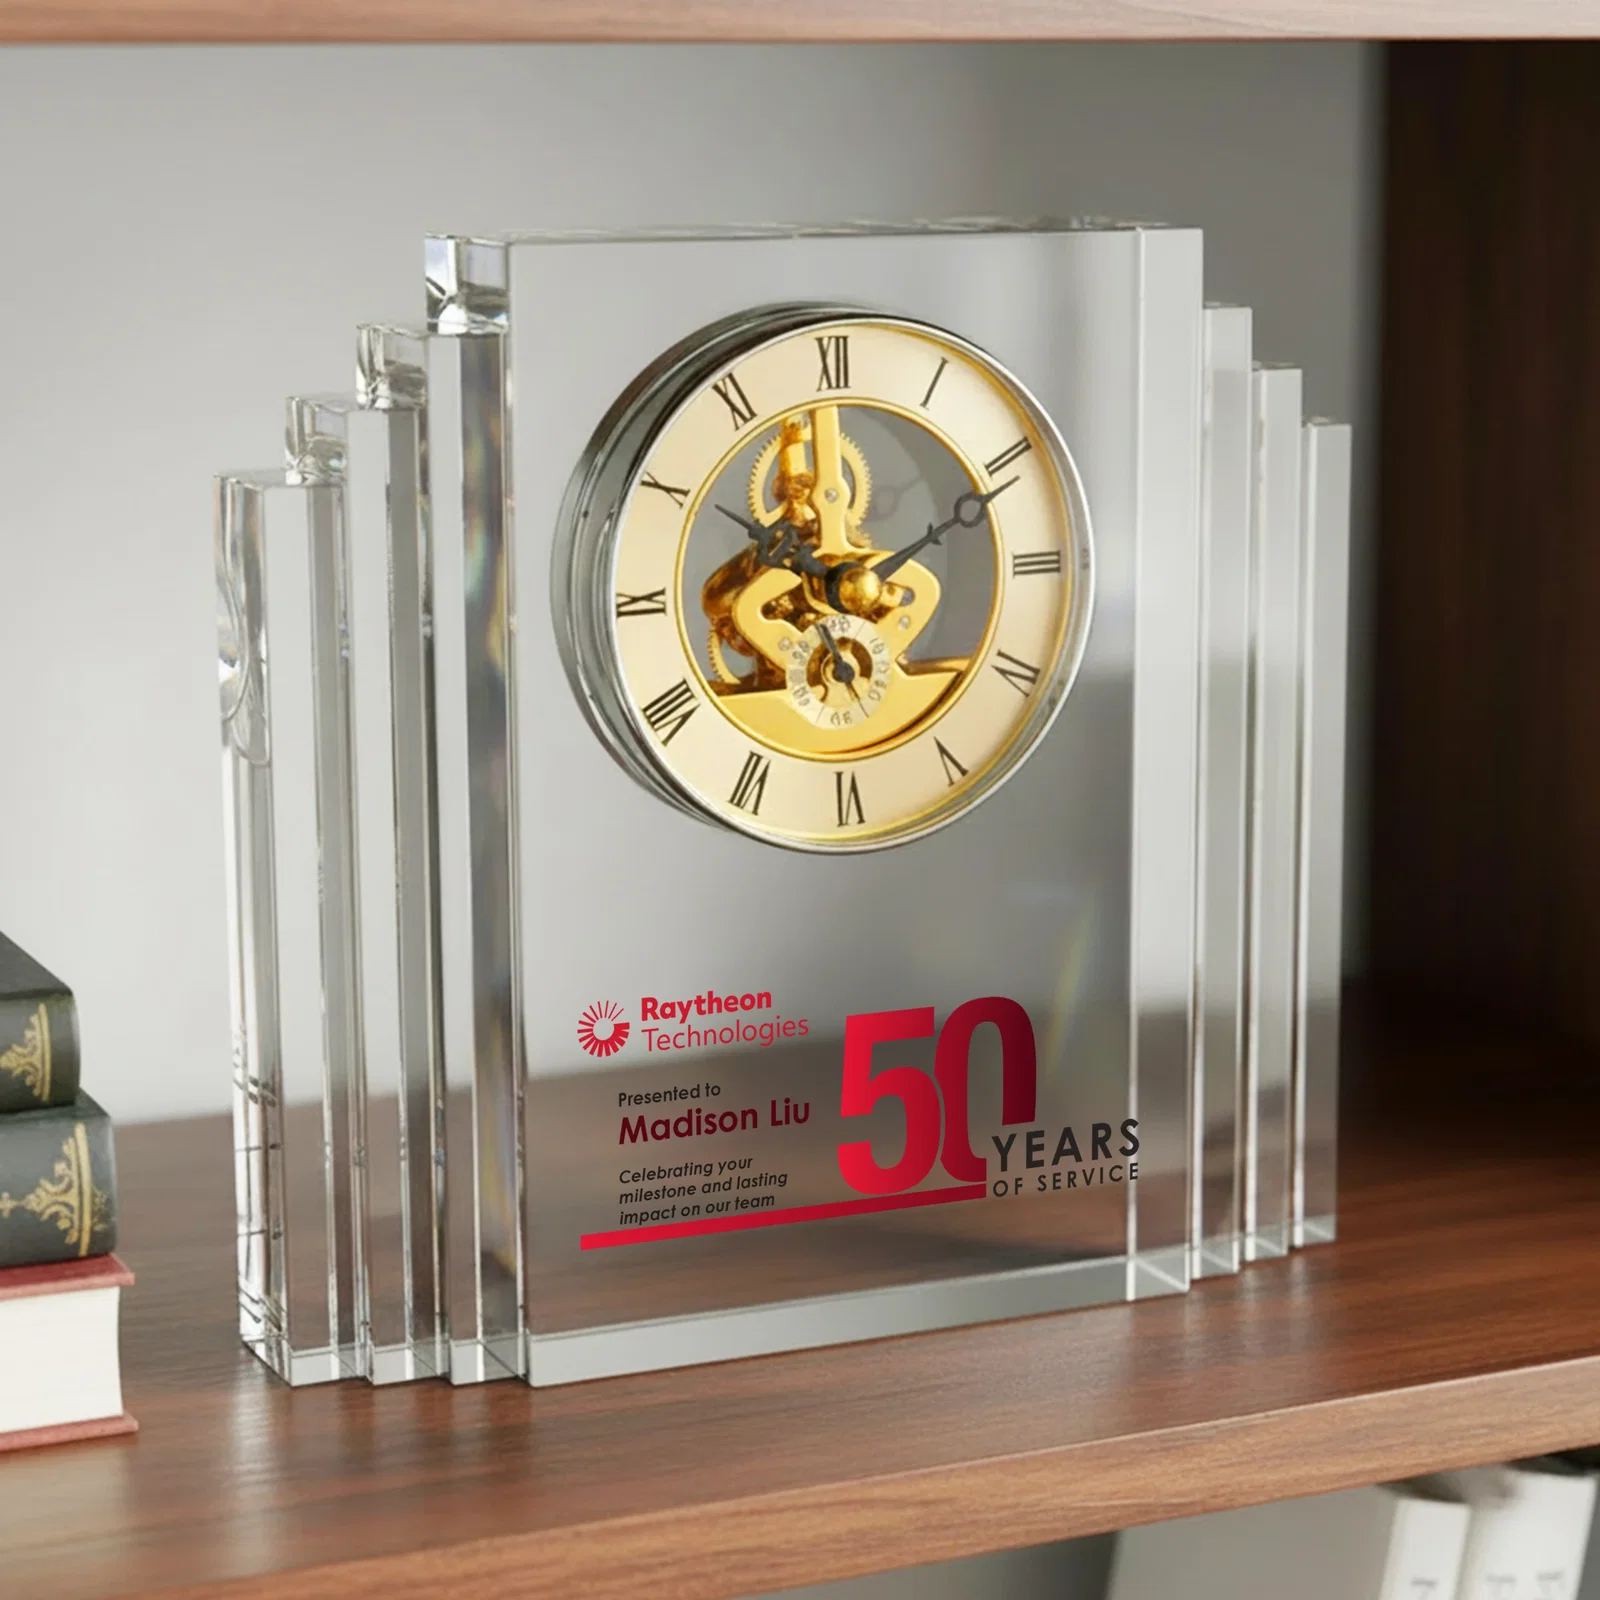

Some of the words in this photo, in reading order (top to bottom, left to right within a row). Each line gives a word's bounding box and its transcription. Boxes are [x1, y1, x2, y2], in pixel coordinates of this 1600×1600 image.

[815, 336, 851, 392] XII
[920, 357, 949, 409] I
[712, 372, 758, 431] XI
[983, 436, 1032, 477] II
[640, 472, 690, 508] X
[1012, 549, 1061, 579] III
[615, 587, 667, 618] IX
[992, 649, 1041, 698] IV
[642, 678, 700, 746] VIII
[727, 751, 773, 816] VII
[933, 736, 969, 787] V
[834, 770, 866, 827] VI
[641, 990, 772, 1024] Raytheon
[641, 1015, 809, 1052] Technologies
[618, 1084, 701, 1107] Presented
[705, 1083, 721, 1097] to
[837, 996, 1037, 1195] 50
[618, 1107, 758, 1145] Madison
[770, 1097, 810, 1127] Liu
[991, 1118, 1140, 1173] YEARS
[619, 1161, 713, 1184] Celebrating
[718, 1157, 753, 1175] your
[619, 1184, 697, 1205] milestone
[701, 1177, 732, 1194] and
[736, 1172, 788, 1190] lasting
[992, 1177, 1023, 1198] OF
[1037, 1162, 1139, 1192] SERVICE
[619, 1207, 677, 1226] impact
[680, 1205, 701, 1217] on
[705, 1201, 731, 1214] our
[735, 1194, 775, 1211] team
